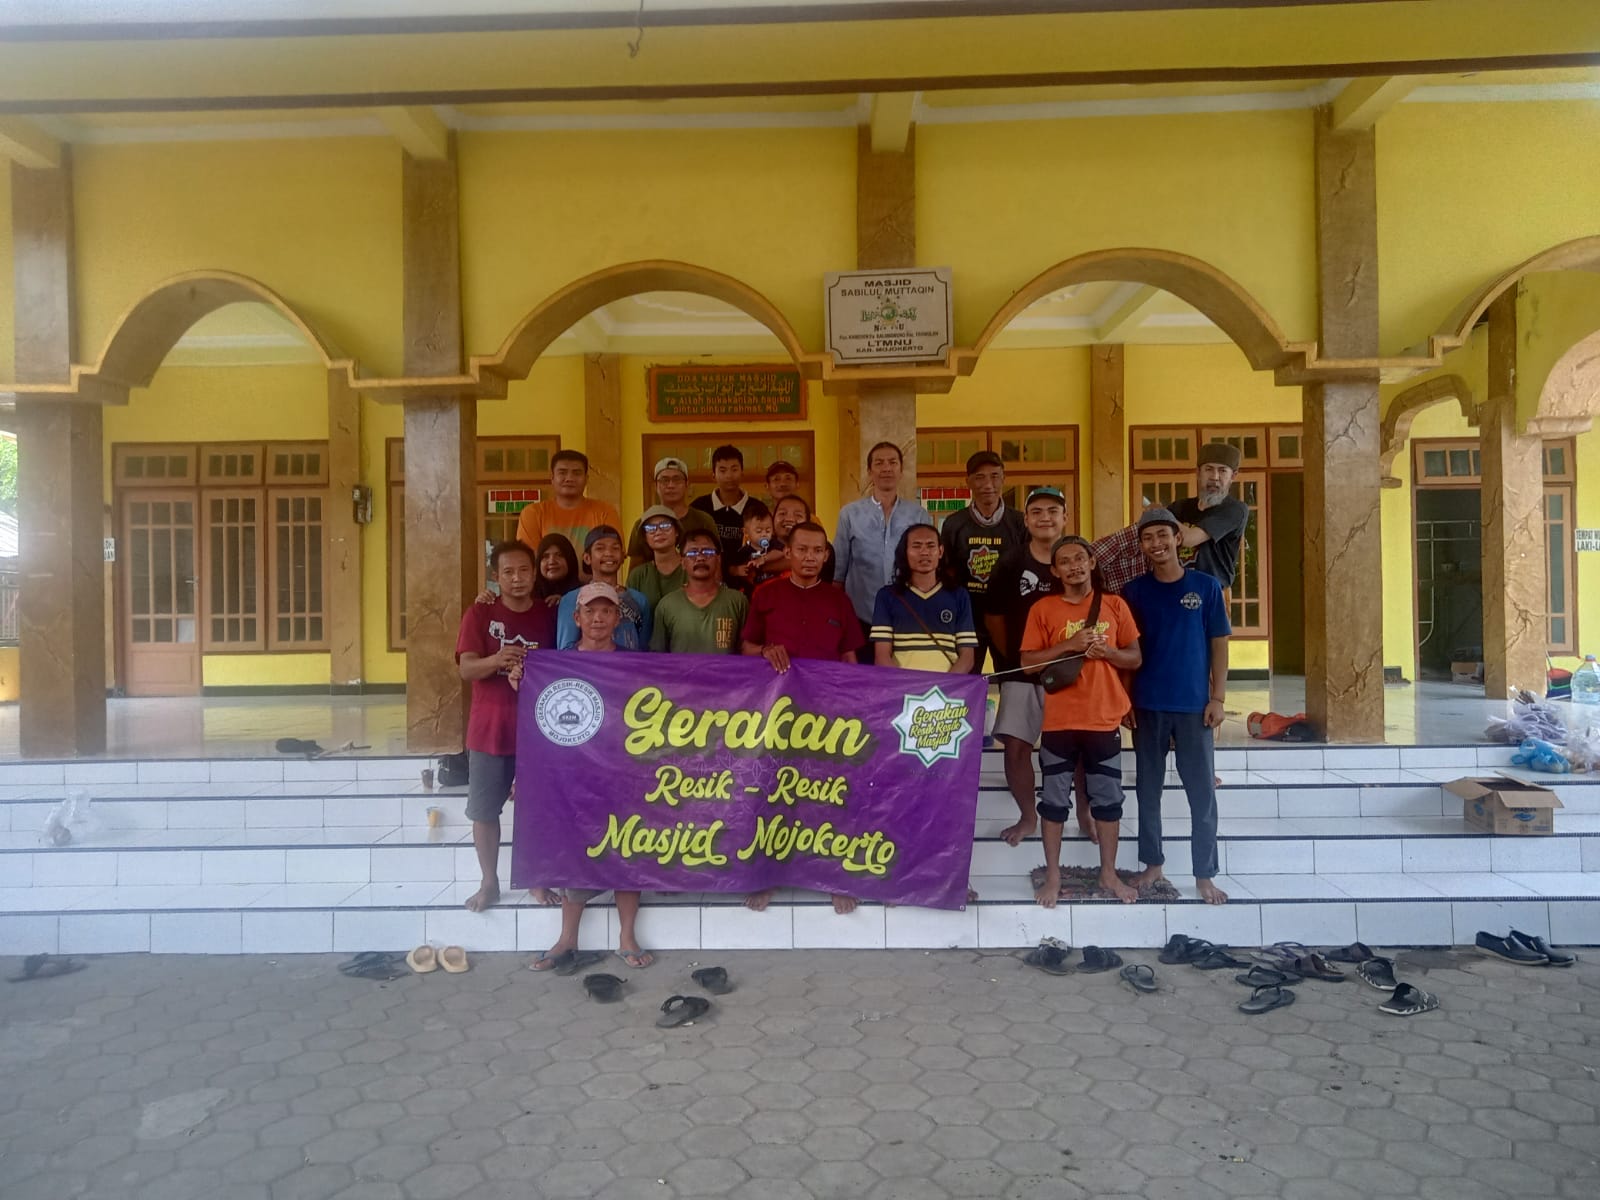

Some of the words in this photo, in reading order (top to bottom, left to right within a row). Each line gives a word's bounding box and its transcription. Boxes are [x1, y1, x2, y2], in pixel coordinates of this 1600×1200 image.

[864, 279, 912, 288] MASJID
[841, 287, 882, 297] SABILUL
[884, 286, 935, 296] MUTTAQIN
[867, 338, 912, 347] LTMNU
[875, 345, 924, 353] MOJOKERTO
[716, 617, 733, 630] THE
[716, 630, 733, 642] ONE
[913, 703, 968, 724] Gerakan
[624, 687, 870, 757] Gerakan
[909, 722, 935, 737] Resik
[935, 720, 961, 738] Resik
[548, 730, 591, 743] MOJOKERTO
[916, 733, 951, 751] Masjid
[645, 766, 732, 806] Resik
[768, 766, 848, 806] Resik
[587, 815, 727, 867] Masjid
[736, 815, 896, 875] Mojokerto
